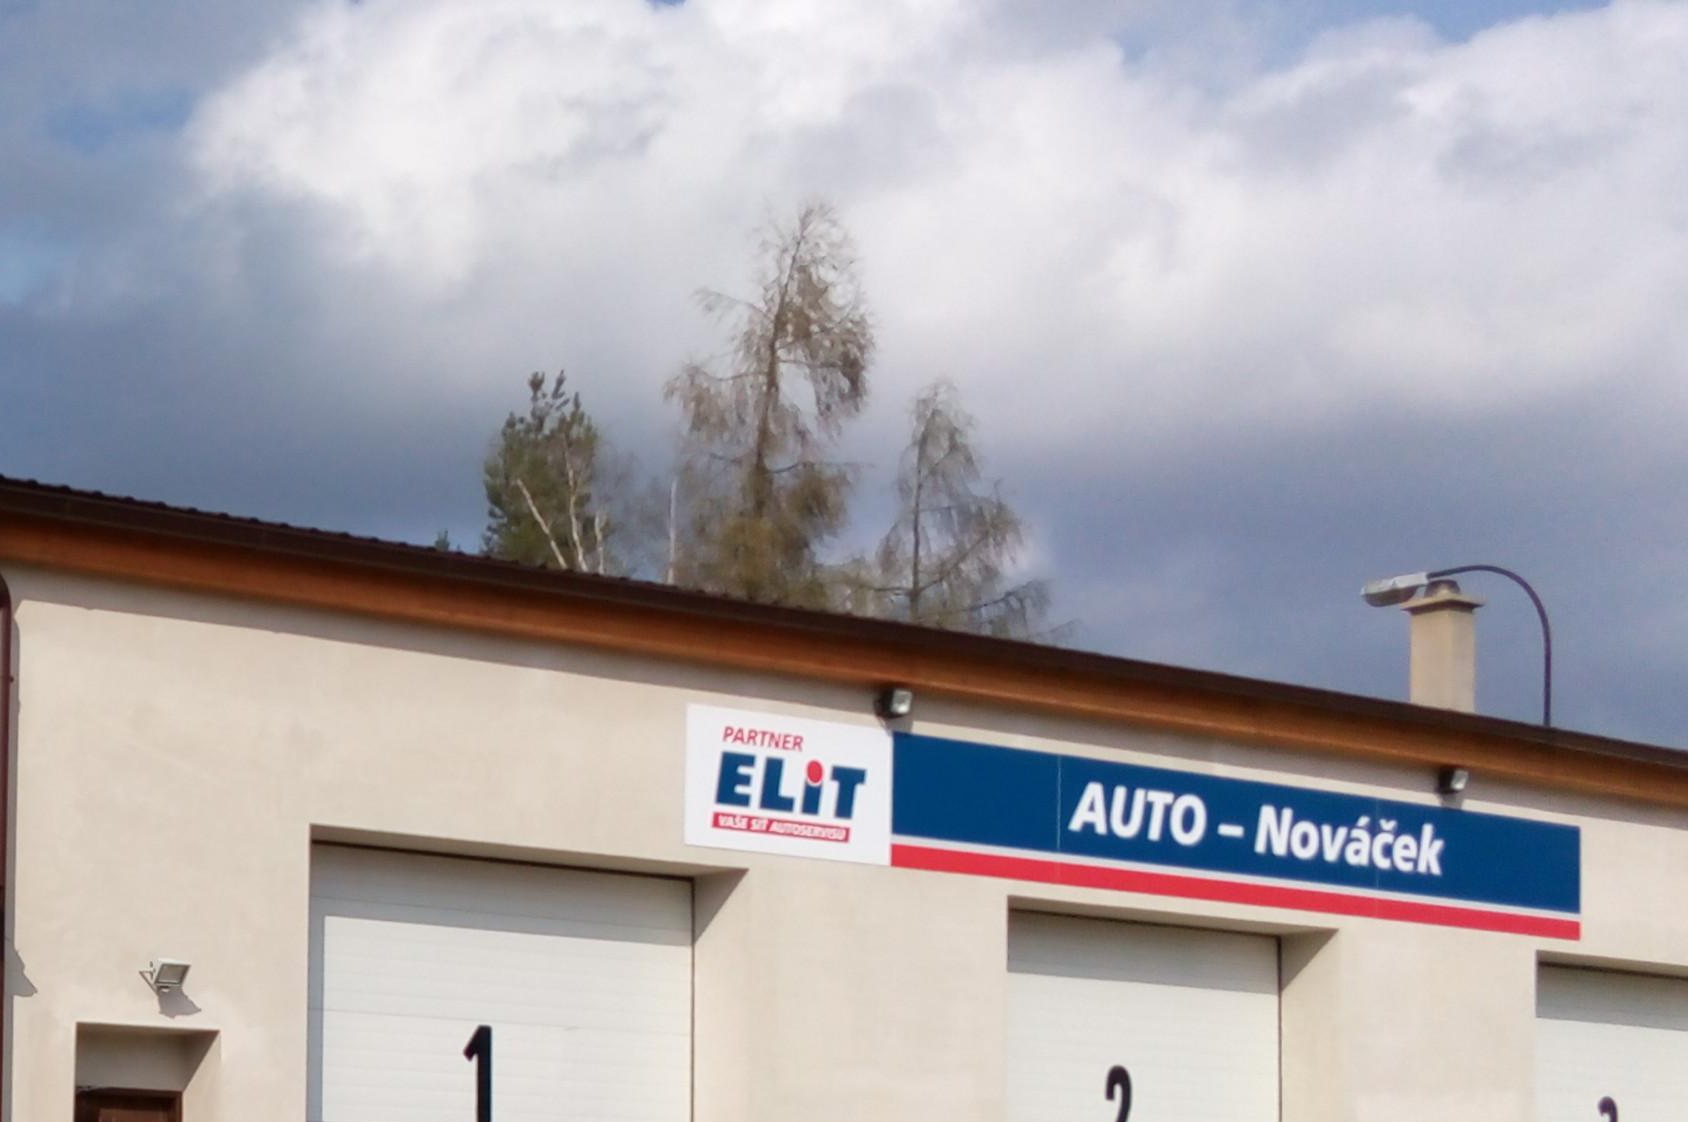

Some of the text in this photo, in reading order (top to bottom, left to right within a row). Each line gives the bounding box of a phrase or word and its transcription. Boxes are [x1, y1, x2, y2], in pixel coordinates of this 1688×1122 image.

[722, 725, 804, 752] PARTNER
[1067, 780, 1207, 846] AUTO
[1253, 803, 1445, 876] Nováček
